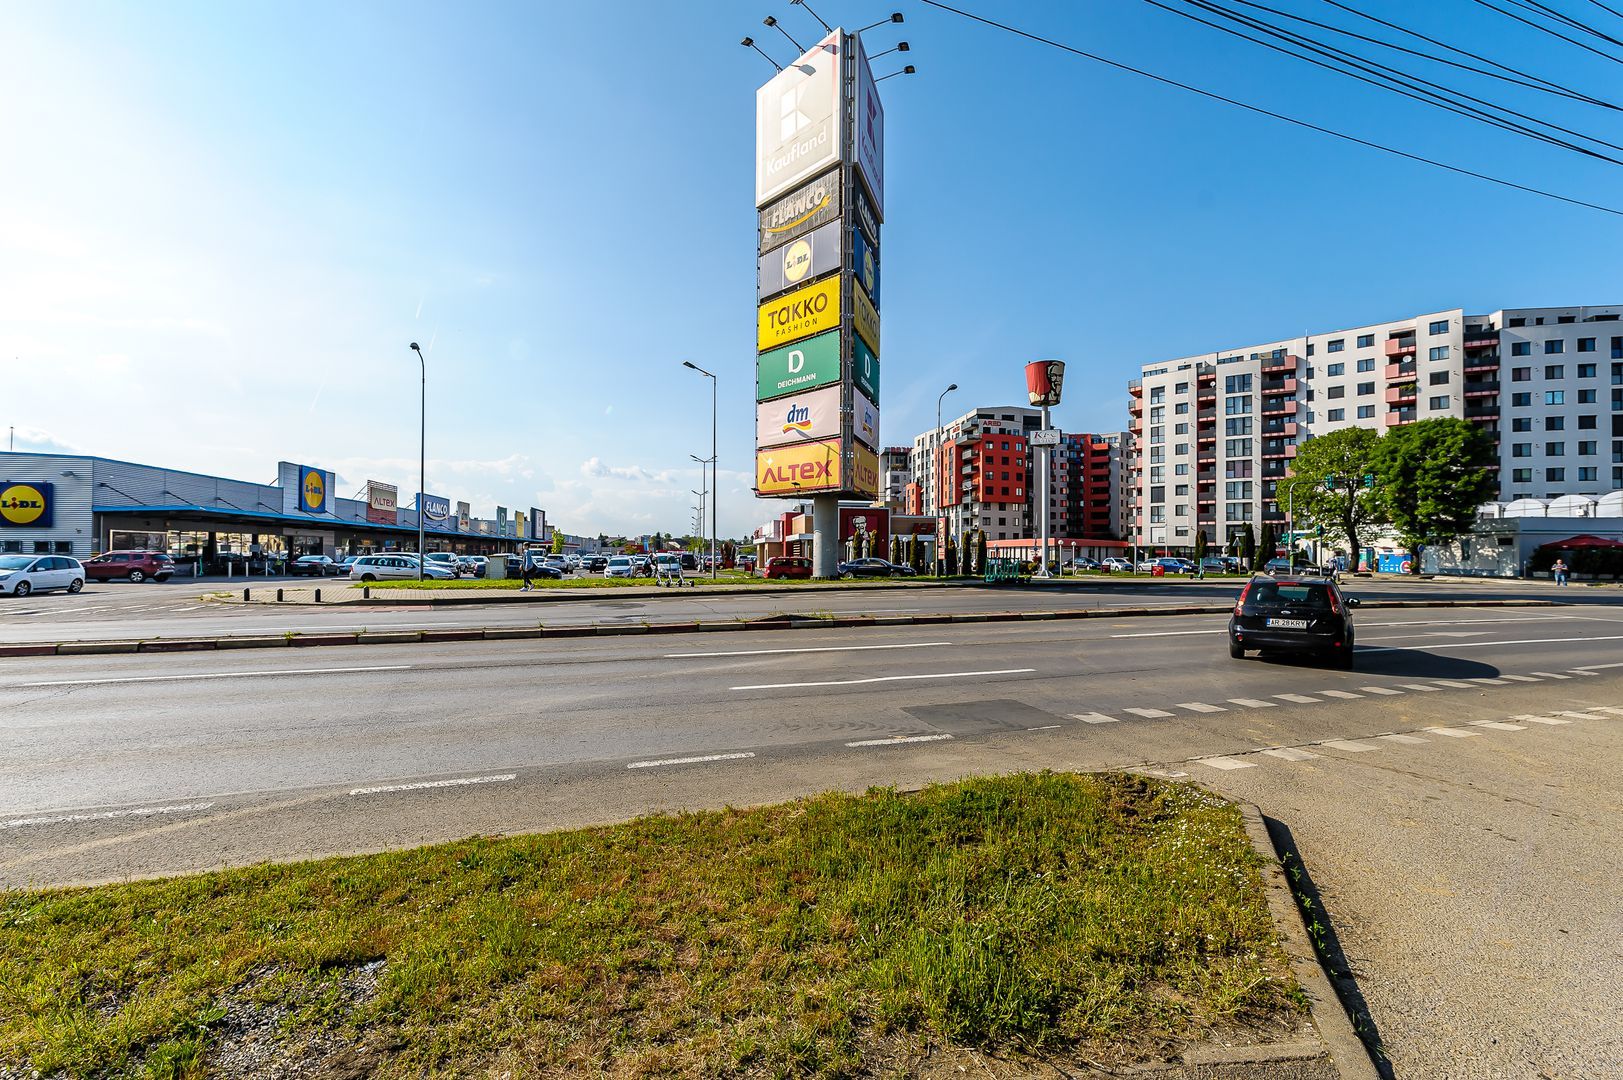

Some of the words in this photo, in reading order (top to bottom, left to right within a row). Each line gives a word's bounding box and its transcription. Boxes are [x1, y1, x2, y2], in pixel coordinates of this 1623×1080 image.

[767, 127, 826, 176] Kaufland
[772, 187, 826, 226] FLANCO
[776, 317, 818, 337] FASHION
[788, 350, 805, 373] D
[777, 373, 816, 388] DEICHMANN
[787, 402, 810, 424] dm
[426, 501, 448, 515] FLANCO
